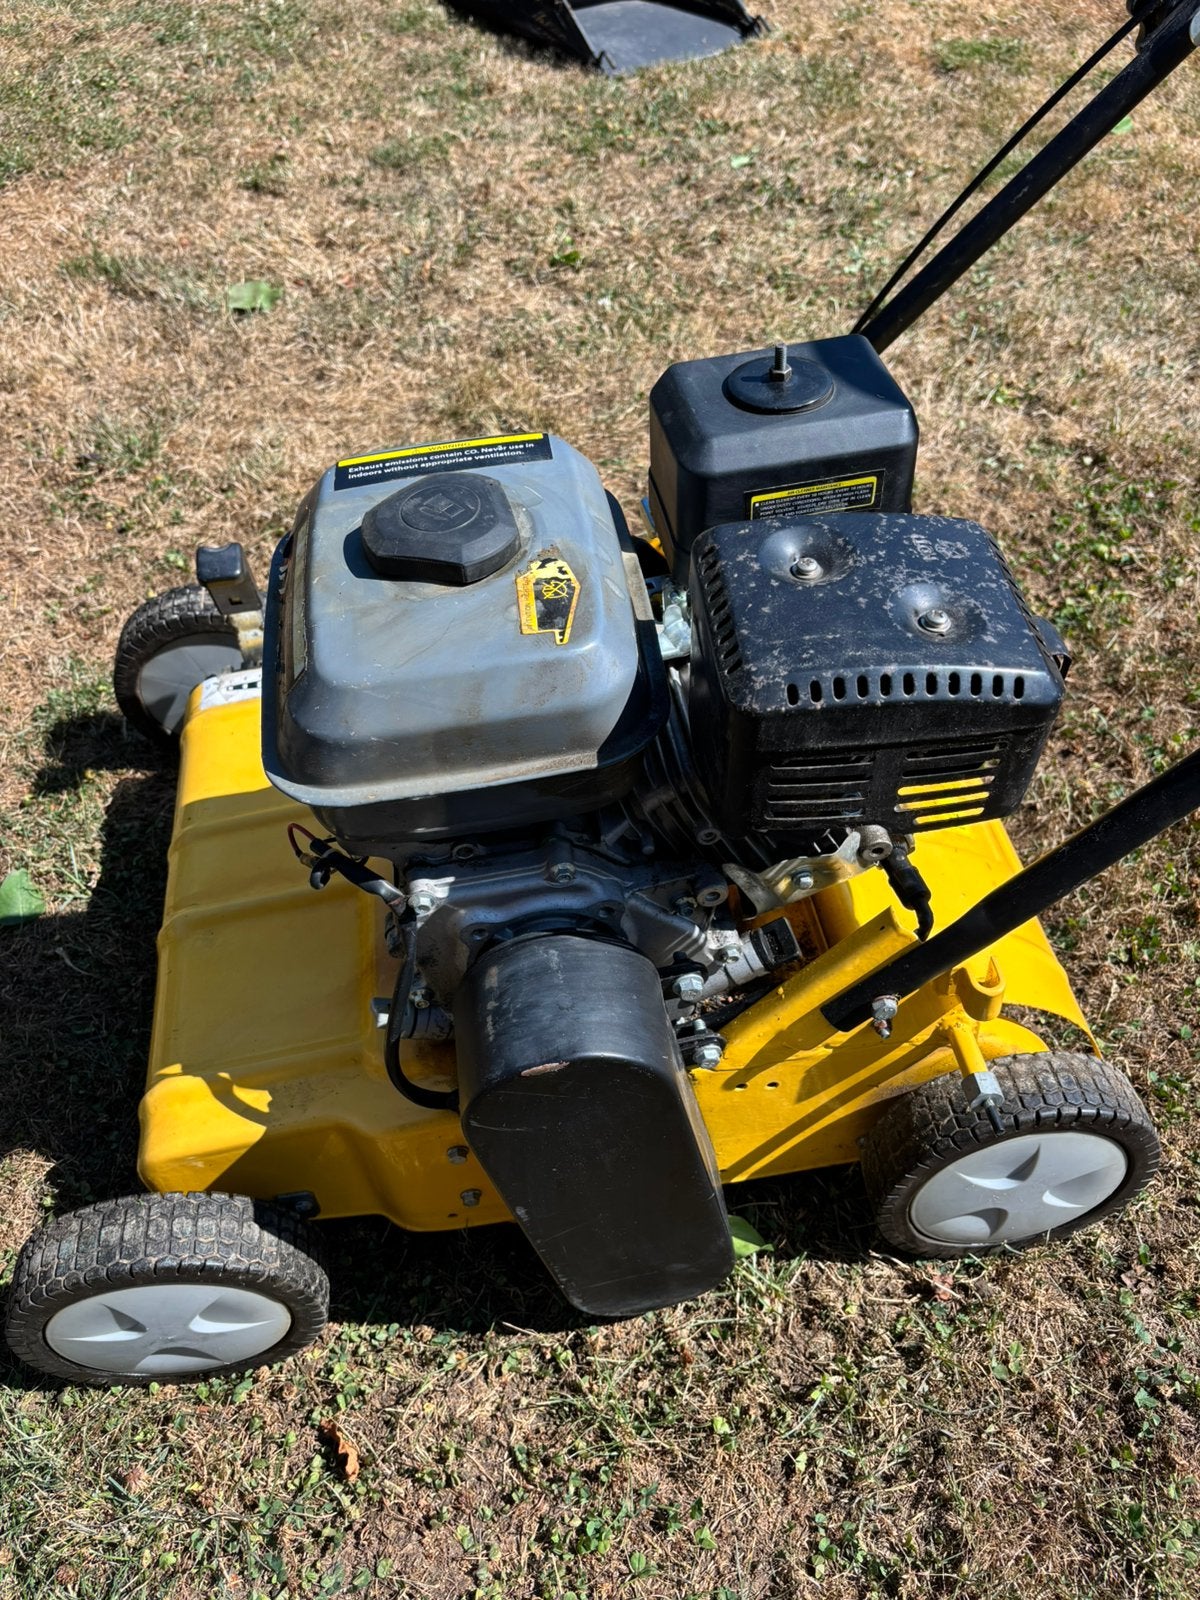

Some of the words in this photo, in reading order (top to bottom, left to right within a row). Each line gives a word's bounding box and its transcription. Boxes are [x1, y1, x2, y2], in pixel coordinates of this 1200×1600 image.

[349, 462, 383, 473] Exhaust
[385, 456, 427, 466] emissions
[430, 450, 462, 460] contain
[481, 445, 506, 453] Never
[384, 461, 418, 473] without
[420, 456, 473, 469] appropriate
[474, 450, 524, 460] ventilation.
